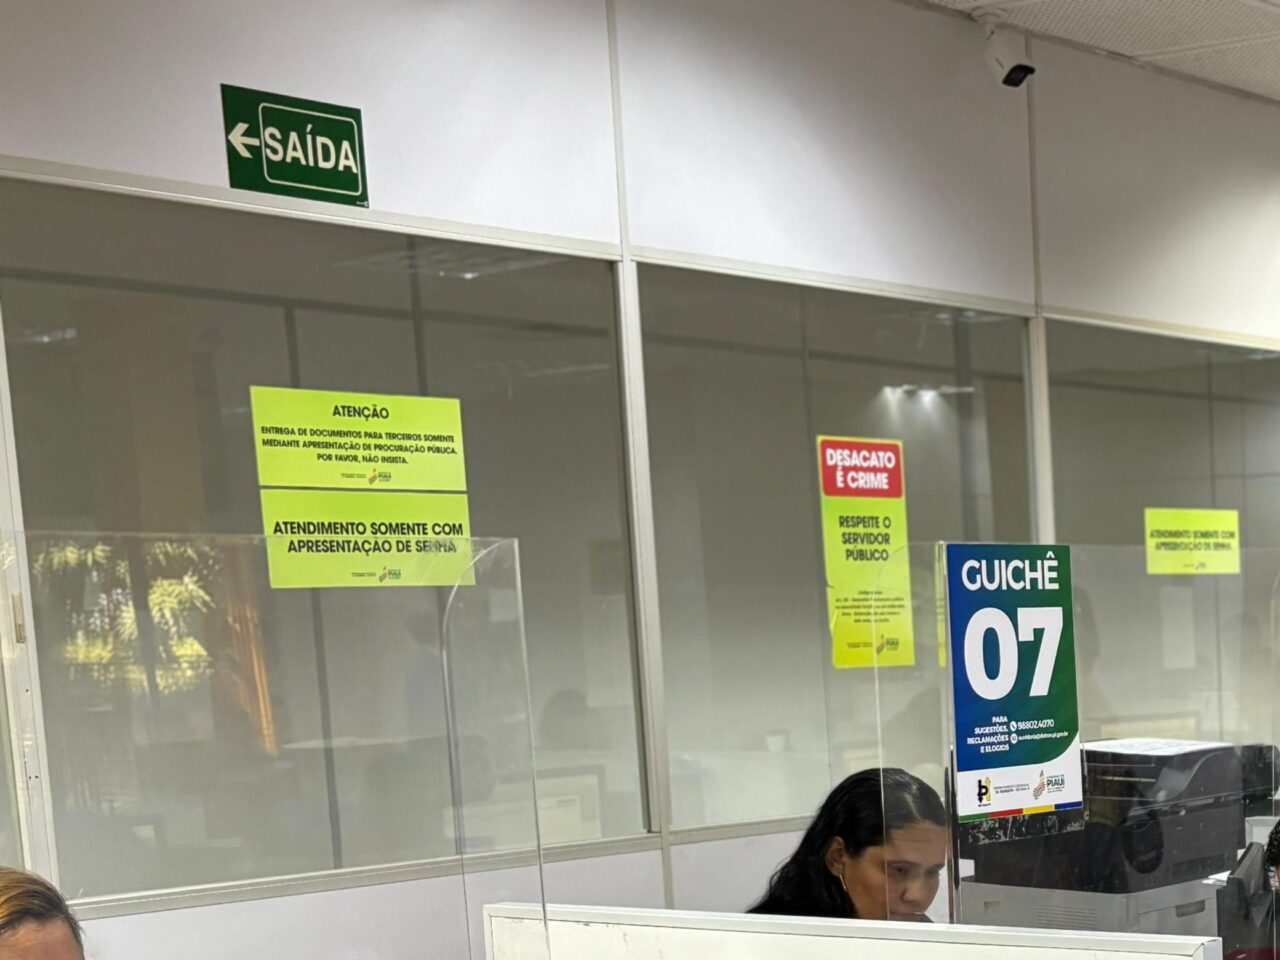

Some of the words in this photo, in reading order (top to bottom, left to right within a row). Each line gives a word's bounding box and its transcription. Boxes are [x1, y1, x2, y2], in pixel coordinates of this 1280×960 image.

[264, 124, 358, 174] SAÍDA
[333, 404, 389, 421] ATENÇÃO
[261, 426, 296, 436] ENTREGA
[298, 428, 308, 437] DE
[309, 428, 362, 439] DOCUMENTOS
[364, 431, 383, 440] PARA
[385, 432, 422, 442] TERCEIROS
[424, 434, 455, 443] SOMENTE
[262, 438, 300, 448] MEDIANTE
[302, 440, 361, 452] APRESENTAÇÃO
[363, 443, 372, 451] DE
[374, 443, 425, 454] PROCURAÇÃO
[317, 453, 333, 462] POR
[335, 454, 360, 464] FAVOR,
[362, 454, 379, 463] NÃO
[826, 448, 896, 469] DESACATO
[836, 467, 845, 488] É
[847, 471, 889, 489] CRIME
[273, 521, 367, 536] ATENDIMENTO
[370, 522, 428, 536] SOMENTE
[432, 523, 463, 536] COM
[838, 515, 880, 529] RESPEITE
[882, 516, 892, 529] O
[288, 537, 391, 556] APRESENTAÇÃO
[397, 540, 412, 553] DE
[841, 532, 890, 545] SERVIDOR
[846, 546, 889, 561] PÚBLICO
[961, 550, 1060, 591] GUICHÊ
[963, 606, 1064, 701] 07
[992, 716, 1008, 724] PARA
